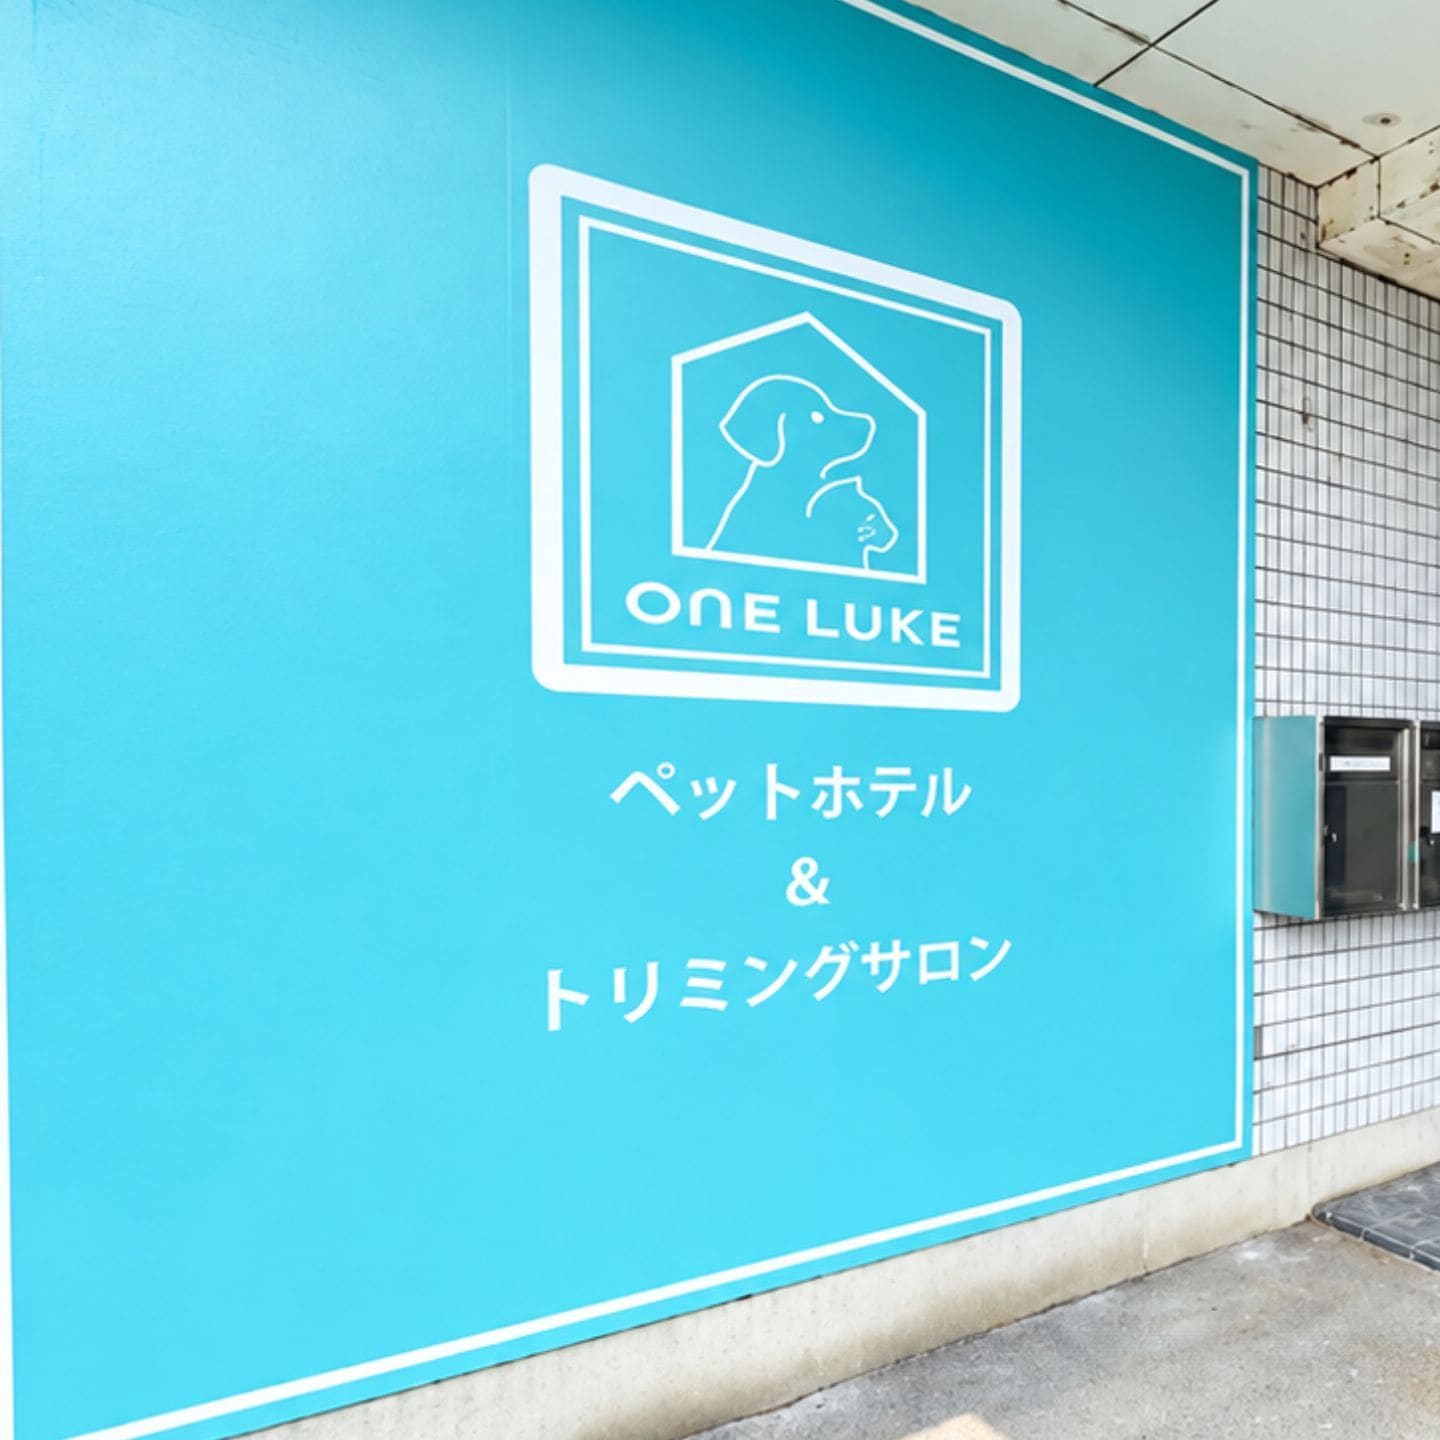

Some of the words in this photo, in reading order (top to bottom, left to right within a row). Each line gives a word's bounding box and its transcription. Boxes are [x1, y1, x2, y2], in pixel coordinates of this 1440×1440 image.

[807, 599, 960, 648] LUKE
[610, 762, 971, 820] ペットホテル
[786, 856, 829, 906] &
[547, 937, 1011, 1031] トリミングサロン
